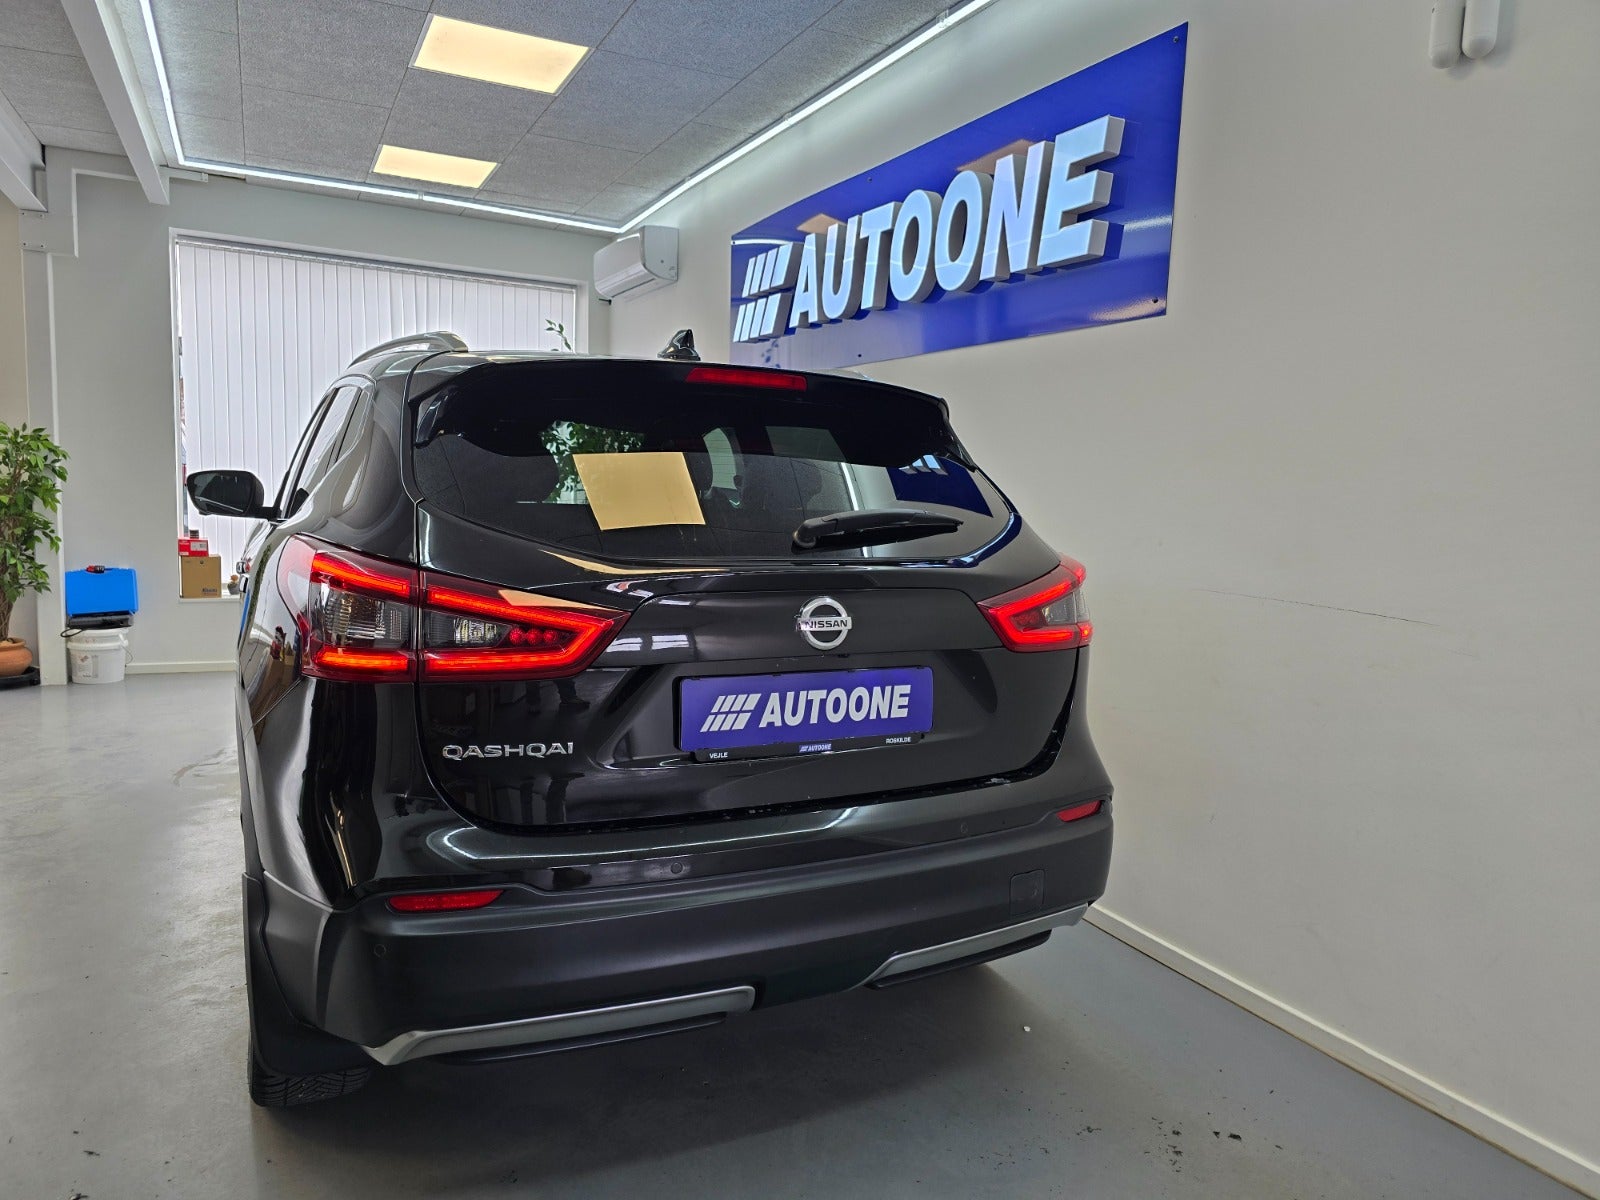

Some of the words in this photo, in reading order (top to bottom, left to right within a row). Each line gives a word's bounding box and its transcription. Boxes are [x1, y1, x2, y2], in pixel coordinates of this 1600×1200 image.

[789, 114, 1125, 329] AUTOONE
[805, 619, 848, 629] NISSAN
[758, 684, 912, 728] AUTOONE
[885, 736, 912, 744] ROSKILDE
[442, 741, 574, 761] QASHQAI
[807, 743, 832, 752] AUTOONE
[709, 751, 729, 759] VEJLE
